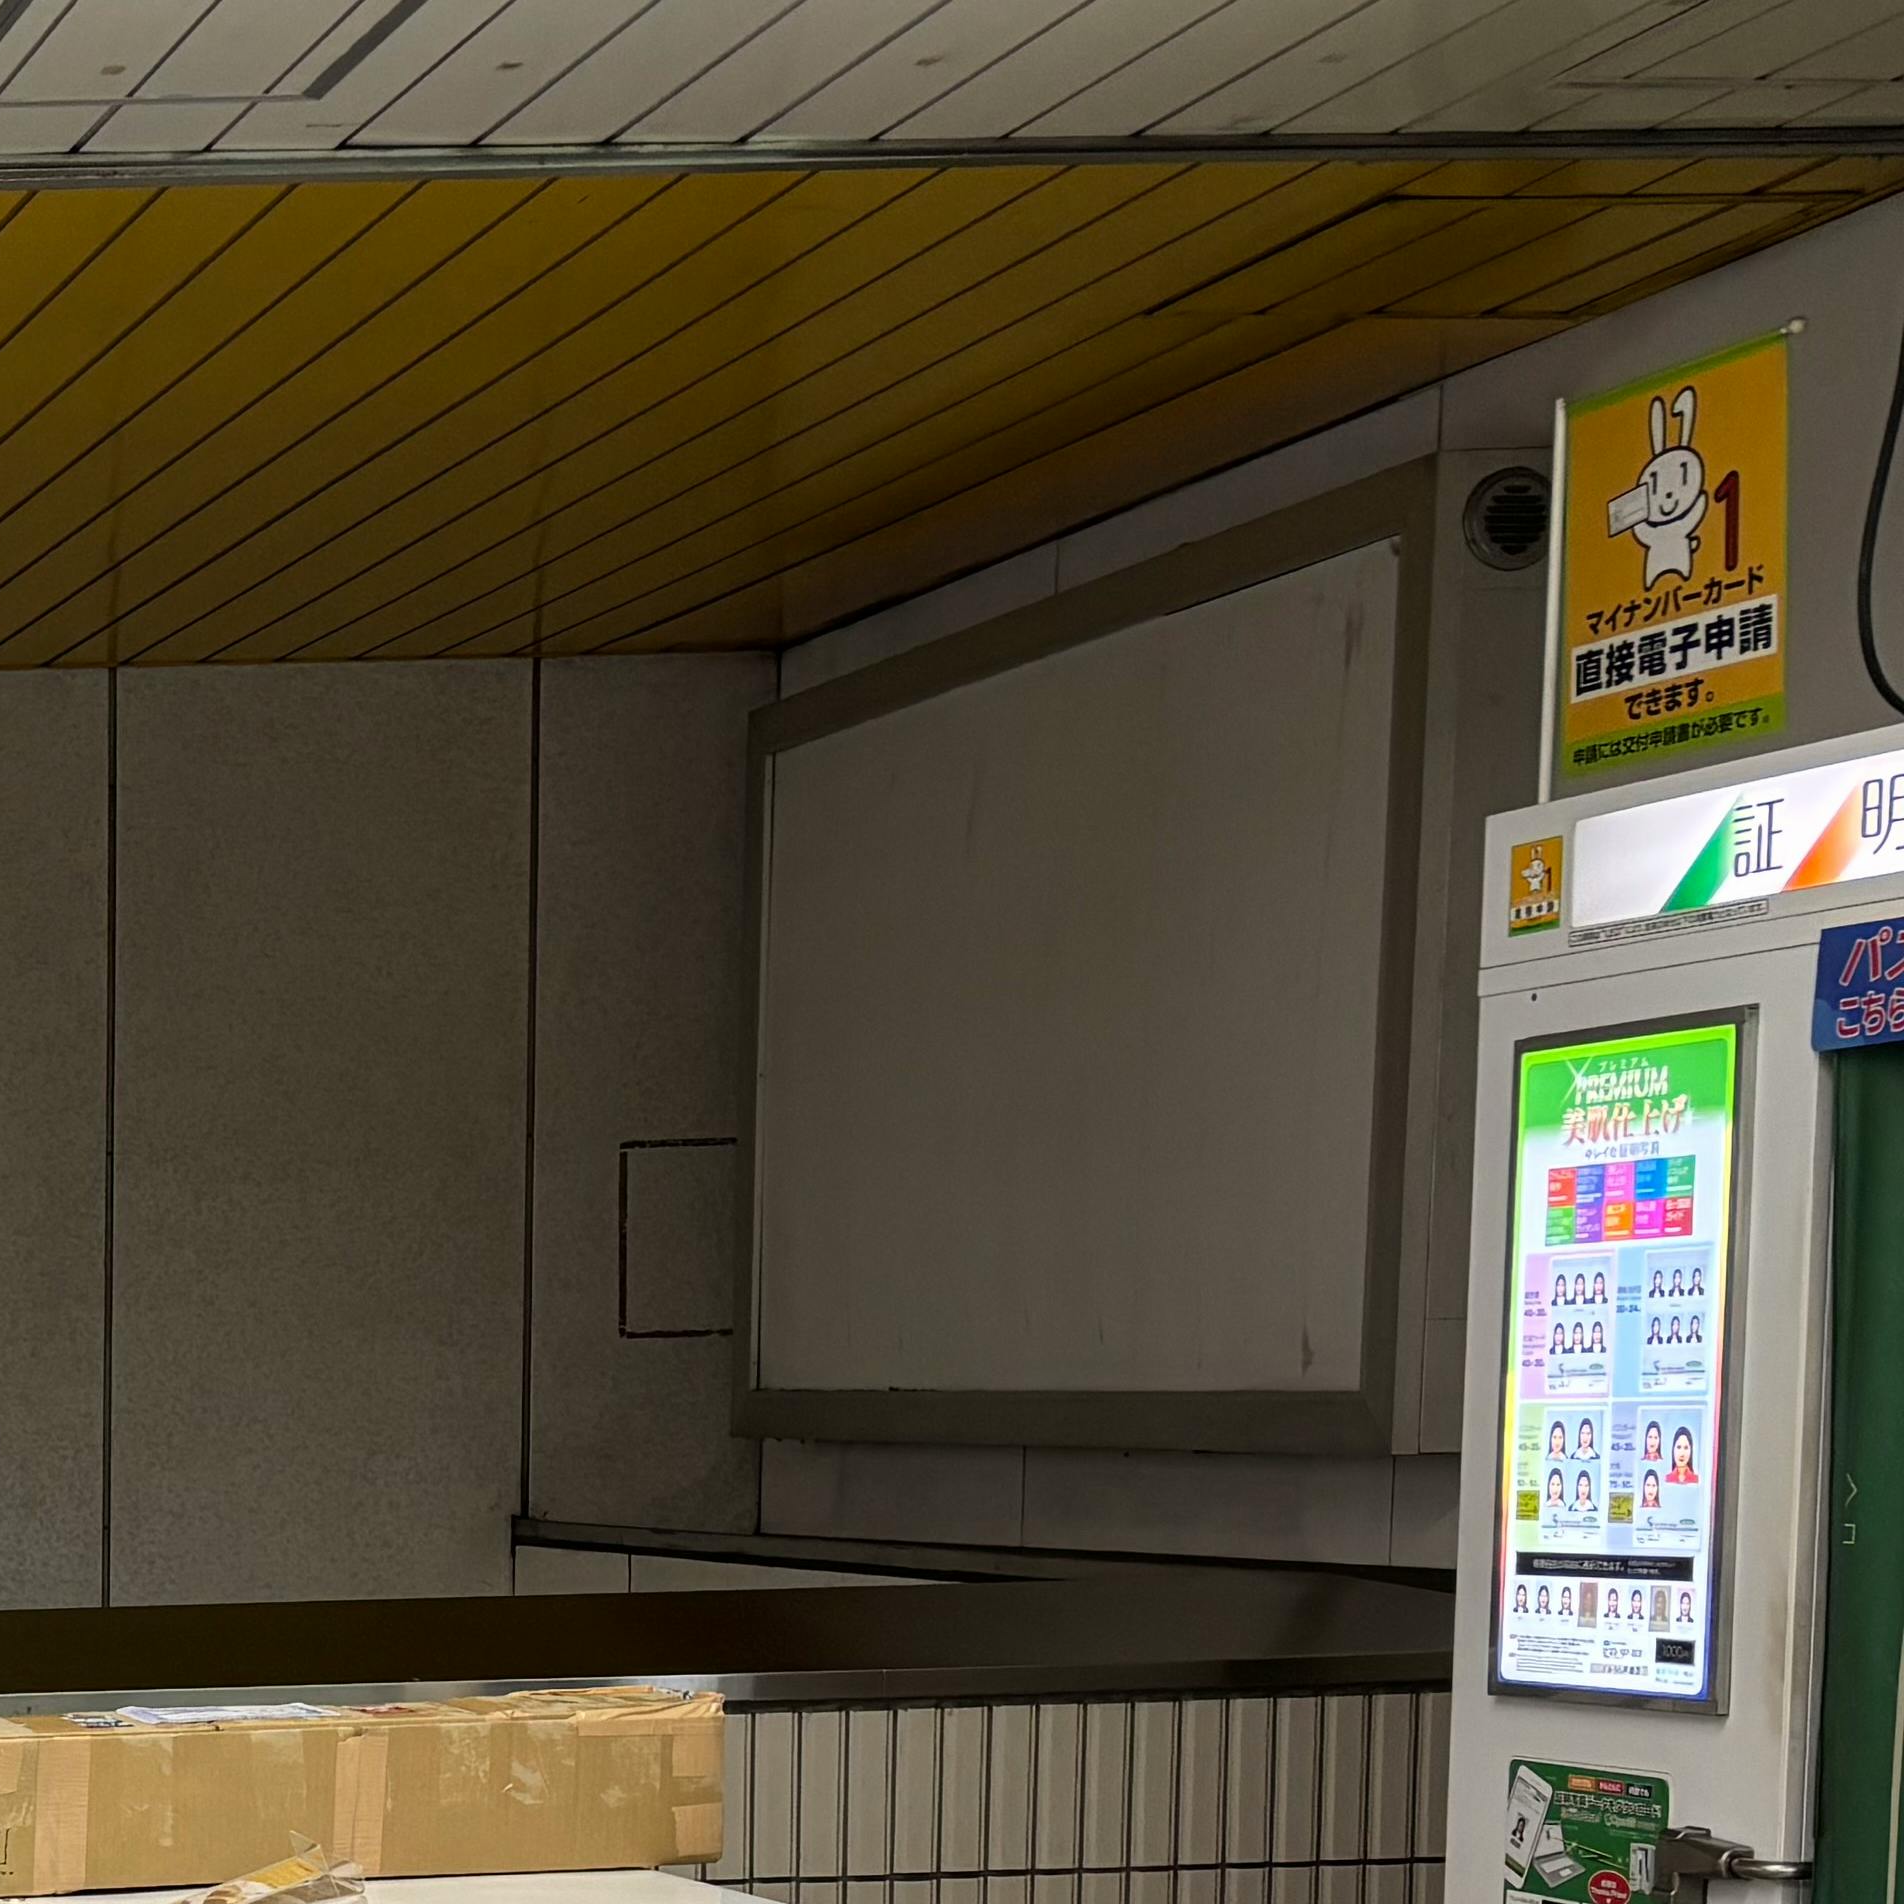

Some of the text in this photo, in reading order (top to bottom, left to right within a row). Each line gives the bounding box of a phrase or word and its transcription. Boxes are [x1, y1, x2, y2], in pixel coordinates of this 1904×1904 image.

[1586, 564, 1764, 635] マイナンバーカード
[1575, 603, 1774, 697] 直接電子申請
[1625, 678, 1715, 721] できます。
[1562, 1094, 1689, 1147] 美肌仕上げ
